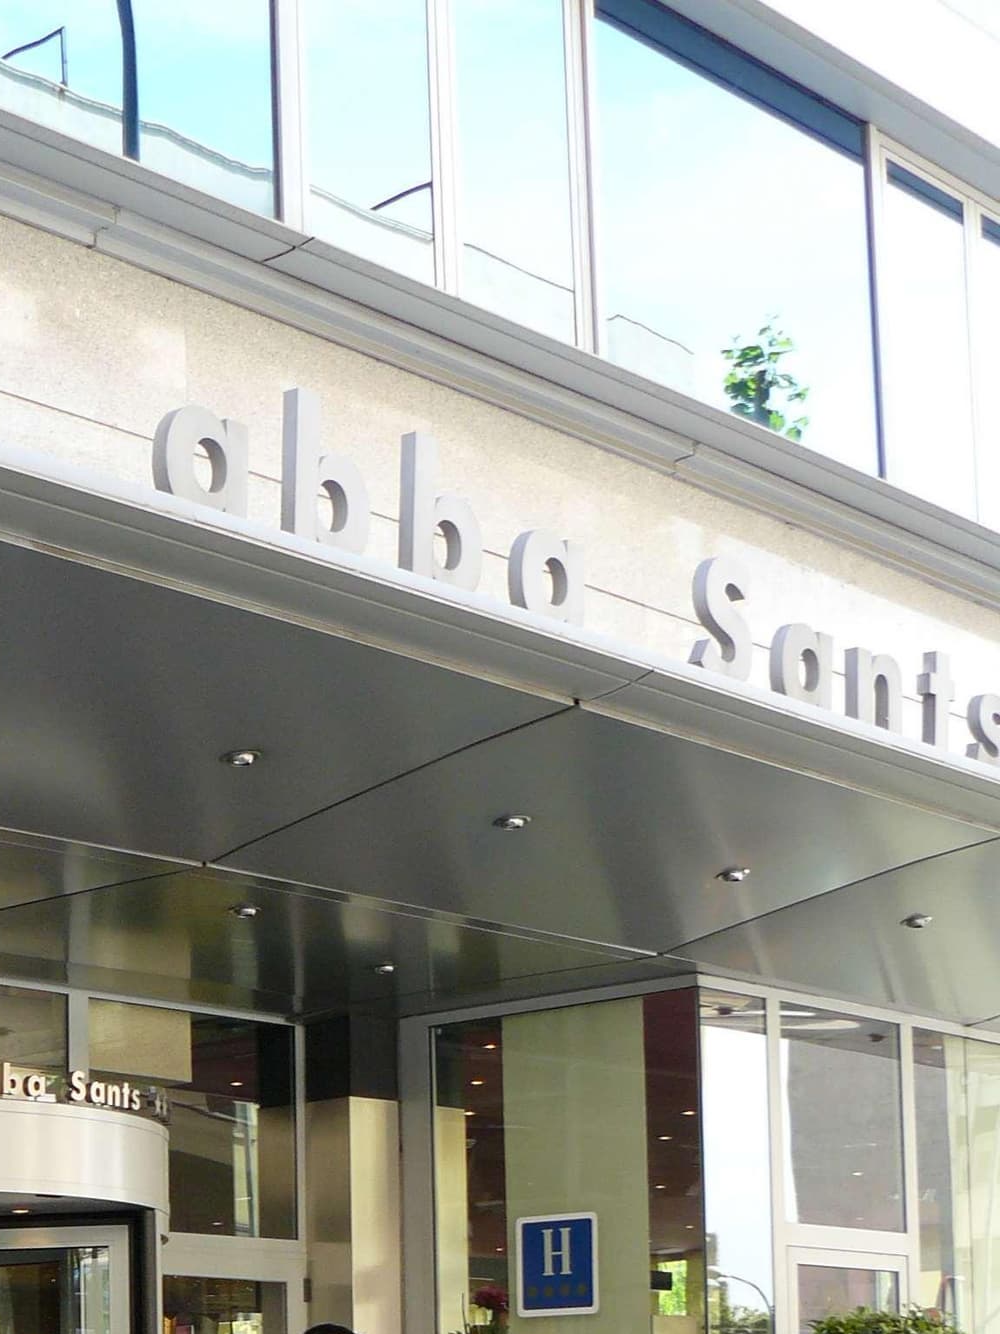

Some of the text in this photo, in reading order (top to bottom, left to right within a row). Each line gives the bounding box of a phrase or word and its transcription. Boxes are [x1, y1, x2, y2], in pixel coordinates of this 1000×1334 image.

[153, 388, 584, 622] abba
[688, 556, 1000, 763] Sants
[70, 1070, 141, 1111] Sants
[541, 1227, 573, 1276] H
